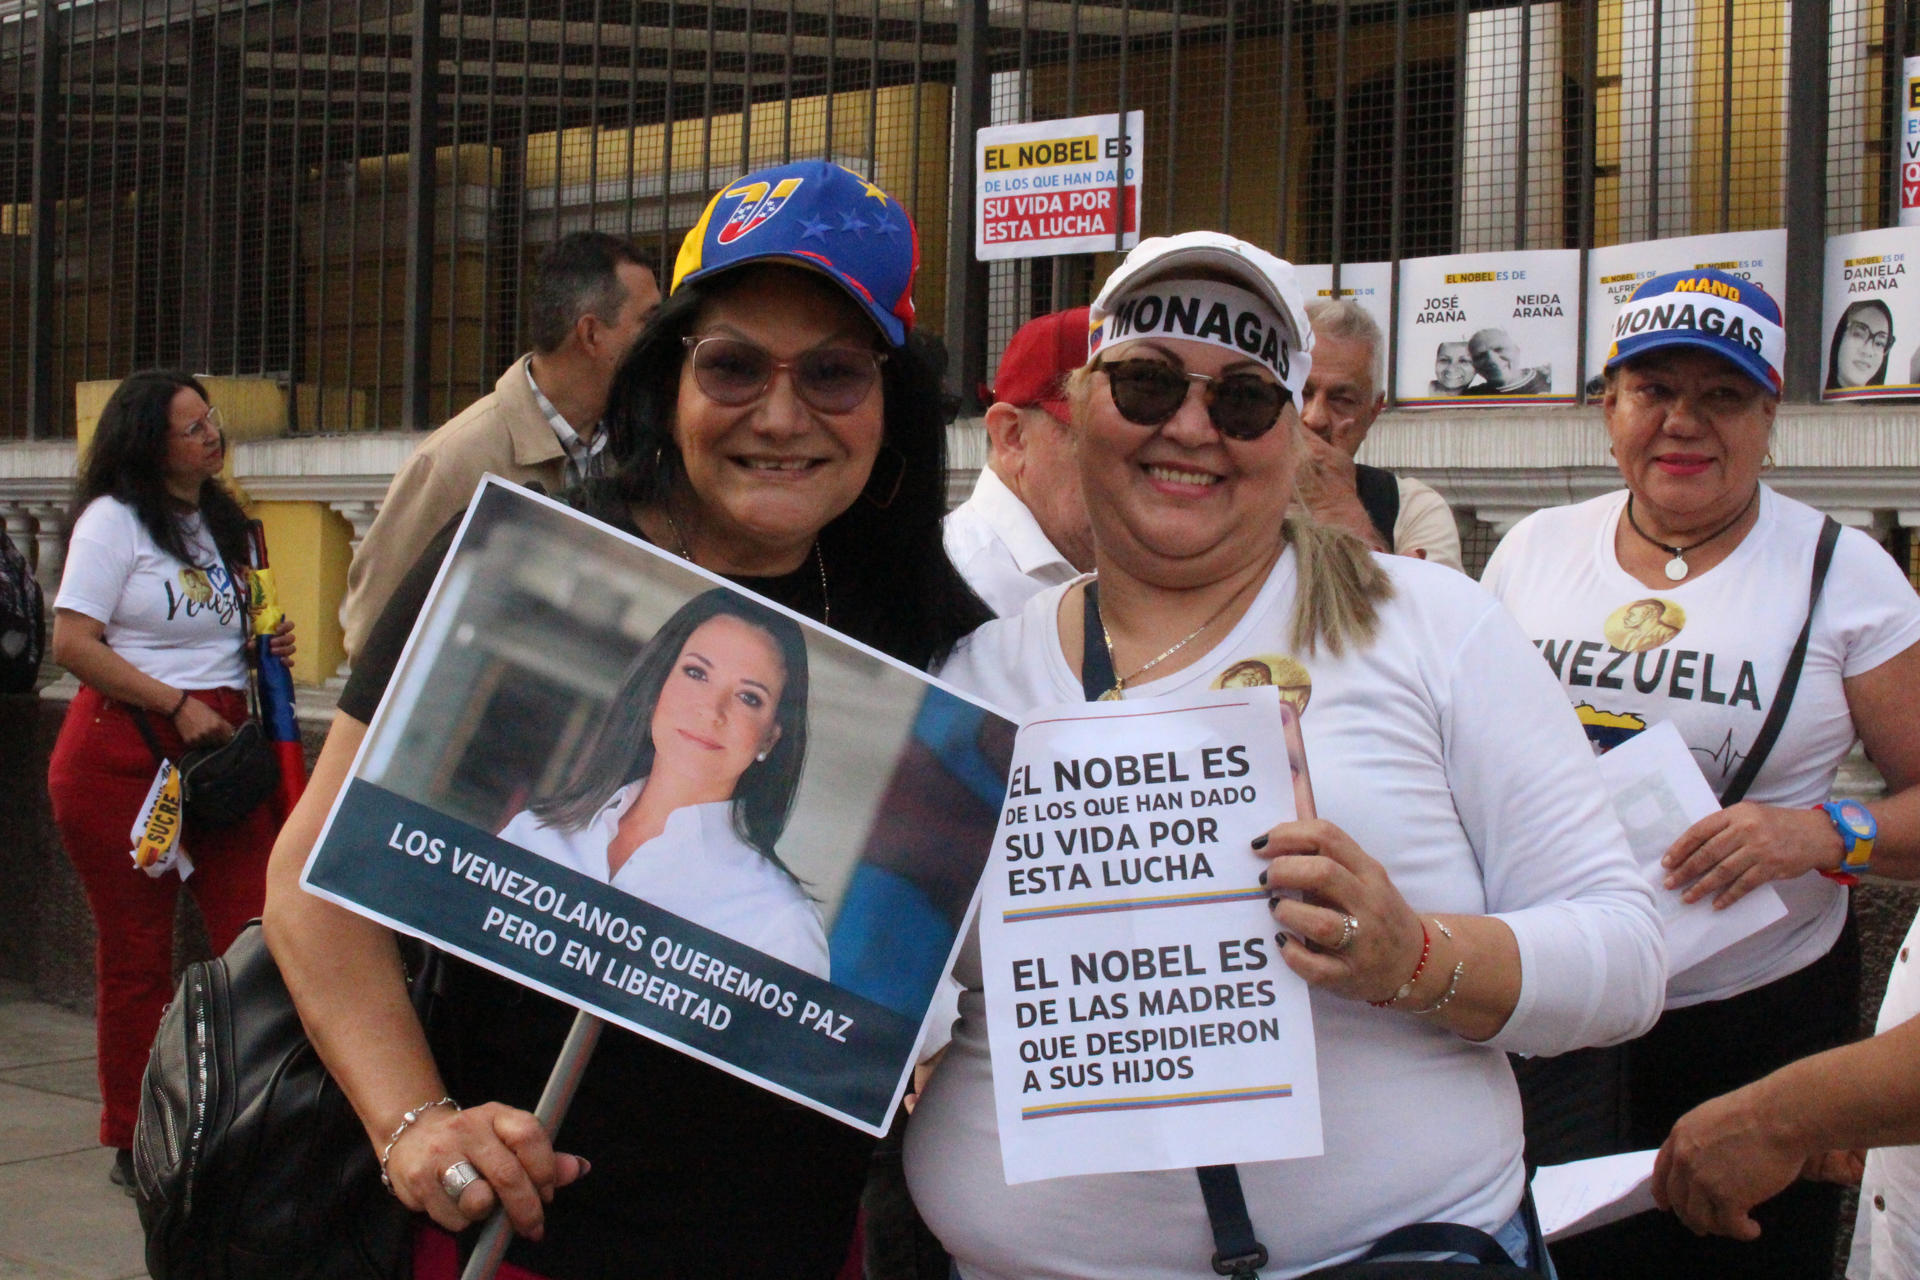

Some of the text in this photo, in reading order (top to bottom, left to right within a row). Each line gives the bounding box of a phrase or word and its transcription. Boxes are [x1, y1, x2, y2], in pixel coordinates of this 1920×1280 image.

[984, 148, 1010, 170] EL
[1018, 140, 1096, 167] NOBEL
[984, 168, 1134, 192] DE LOS QUE HAN DAO
[985, 190, 1110, 219] SU VIDA POR
[985, 214, 1105, 241] ESTA LUCHA
[1446, 271, 1526, 284] EL NOBEL ES DE
[1844, 263, 1905, 280] DANIELA
[1848, 276, 1898, 293] ARAÑA
[1416, 308, 1466, 324] ARAÑA
[1424, 295, 1459, 310] JOSÉ
[1513, 305, 1563, 318] ARAÑA
[1516, 294, 1561, 305] NEIDA
[1109, 295, 1290, 382] MONAGAS
[1615, 304, 1763, 354] MONAGAS
[1532, 639, 1761, 711] NEZUELA
[1009, 745, 1250, 799] EL NOBEL ES
[147, 793, 180, 844] SUCRE
[1006, 785, 1256, 826] DE LOS QUE HAN DADO
[1005, 817, 1219, 862] SU VIDA POR
[1008, 852, 1214, 896] ESTA LUCHA
[388, 822, 855, 1043] LOS VENEZOLANOS QUEREMOS PAZ
[482, 906, 732, 1033] PERO EN LIBERTAD
[1012, 937, 1268, 992] EL NOBEL ES
[1016, 979, 1276, 1028] DE LAS MADRES
[1019, 1018, 1279, 1063] QUE DESPIDIERON
[1022, 1055, 1194, 1093] A SUS HIJOS
